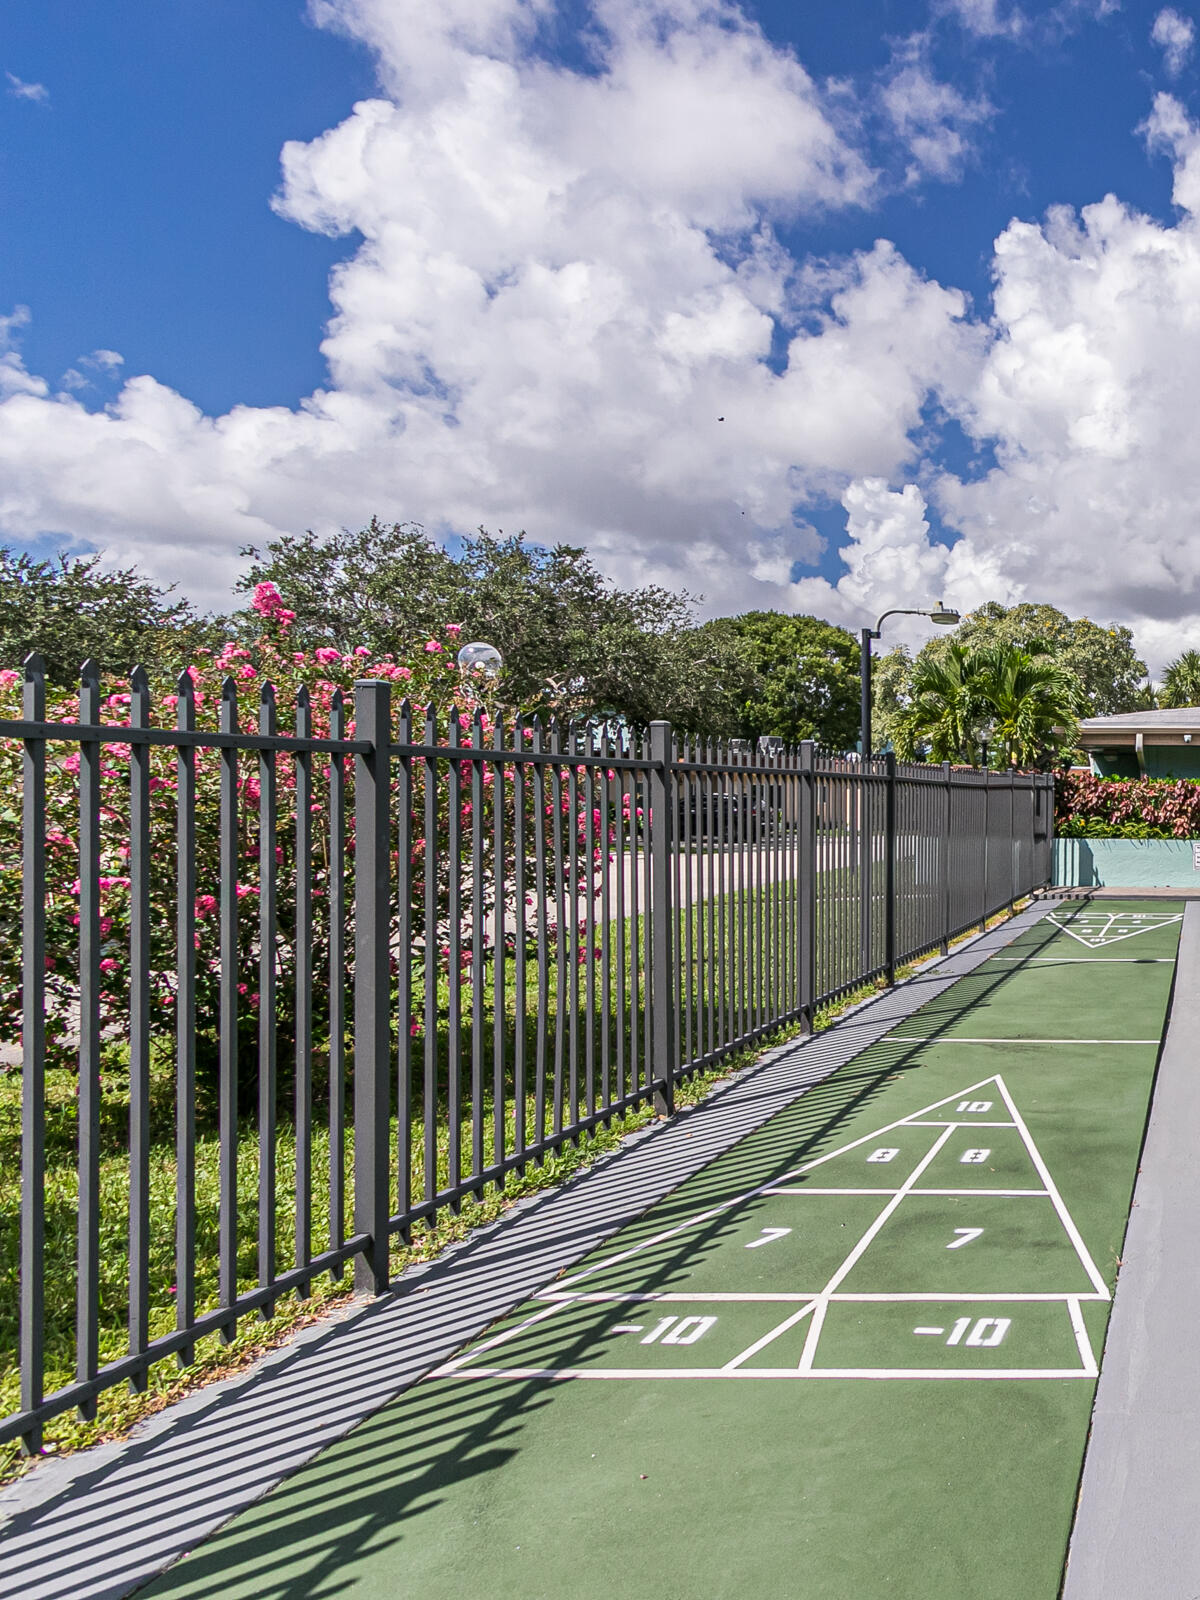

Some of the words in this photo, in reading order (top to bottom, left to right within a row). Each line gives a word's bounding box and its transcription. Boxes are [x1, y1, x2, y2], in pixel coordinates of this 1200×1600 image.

[956, 1100, 993, 1113] 10
[865, 1148, 900, 1163] 8
[959, 1148, 992, 1163] 8
[743, 1227, 793, 1249] 7
[945, 1227, 985, 1249] 7
[611, 1315, 719, 1345] -10
[912, 1316, 1012, 1347] -10
